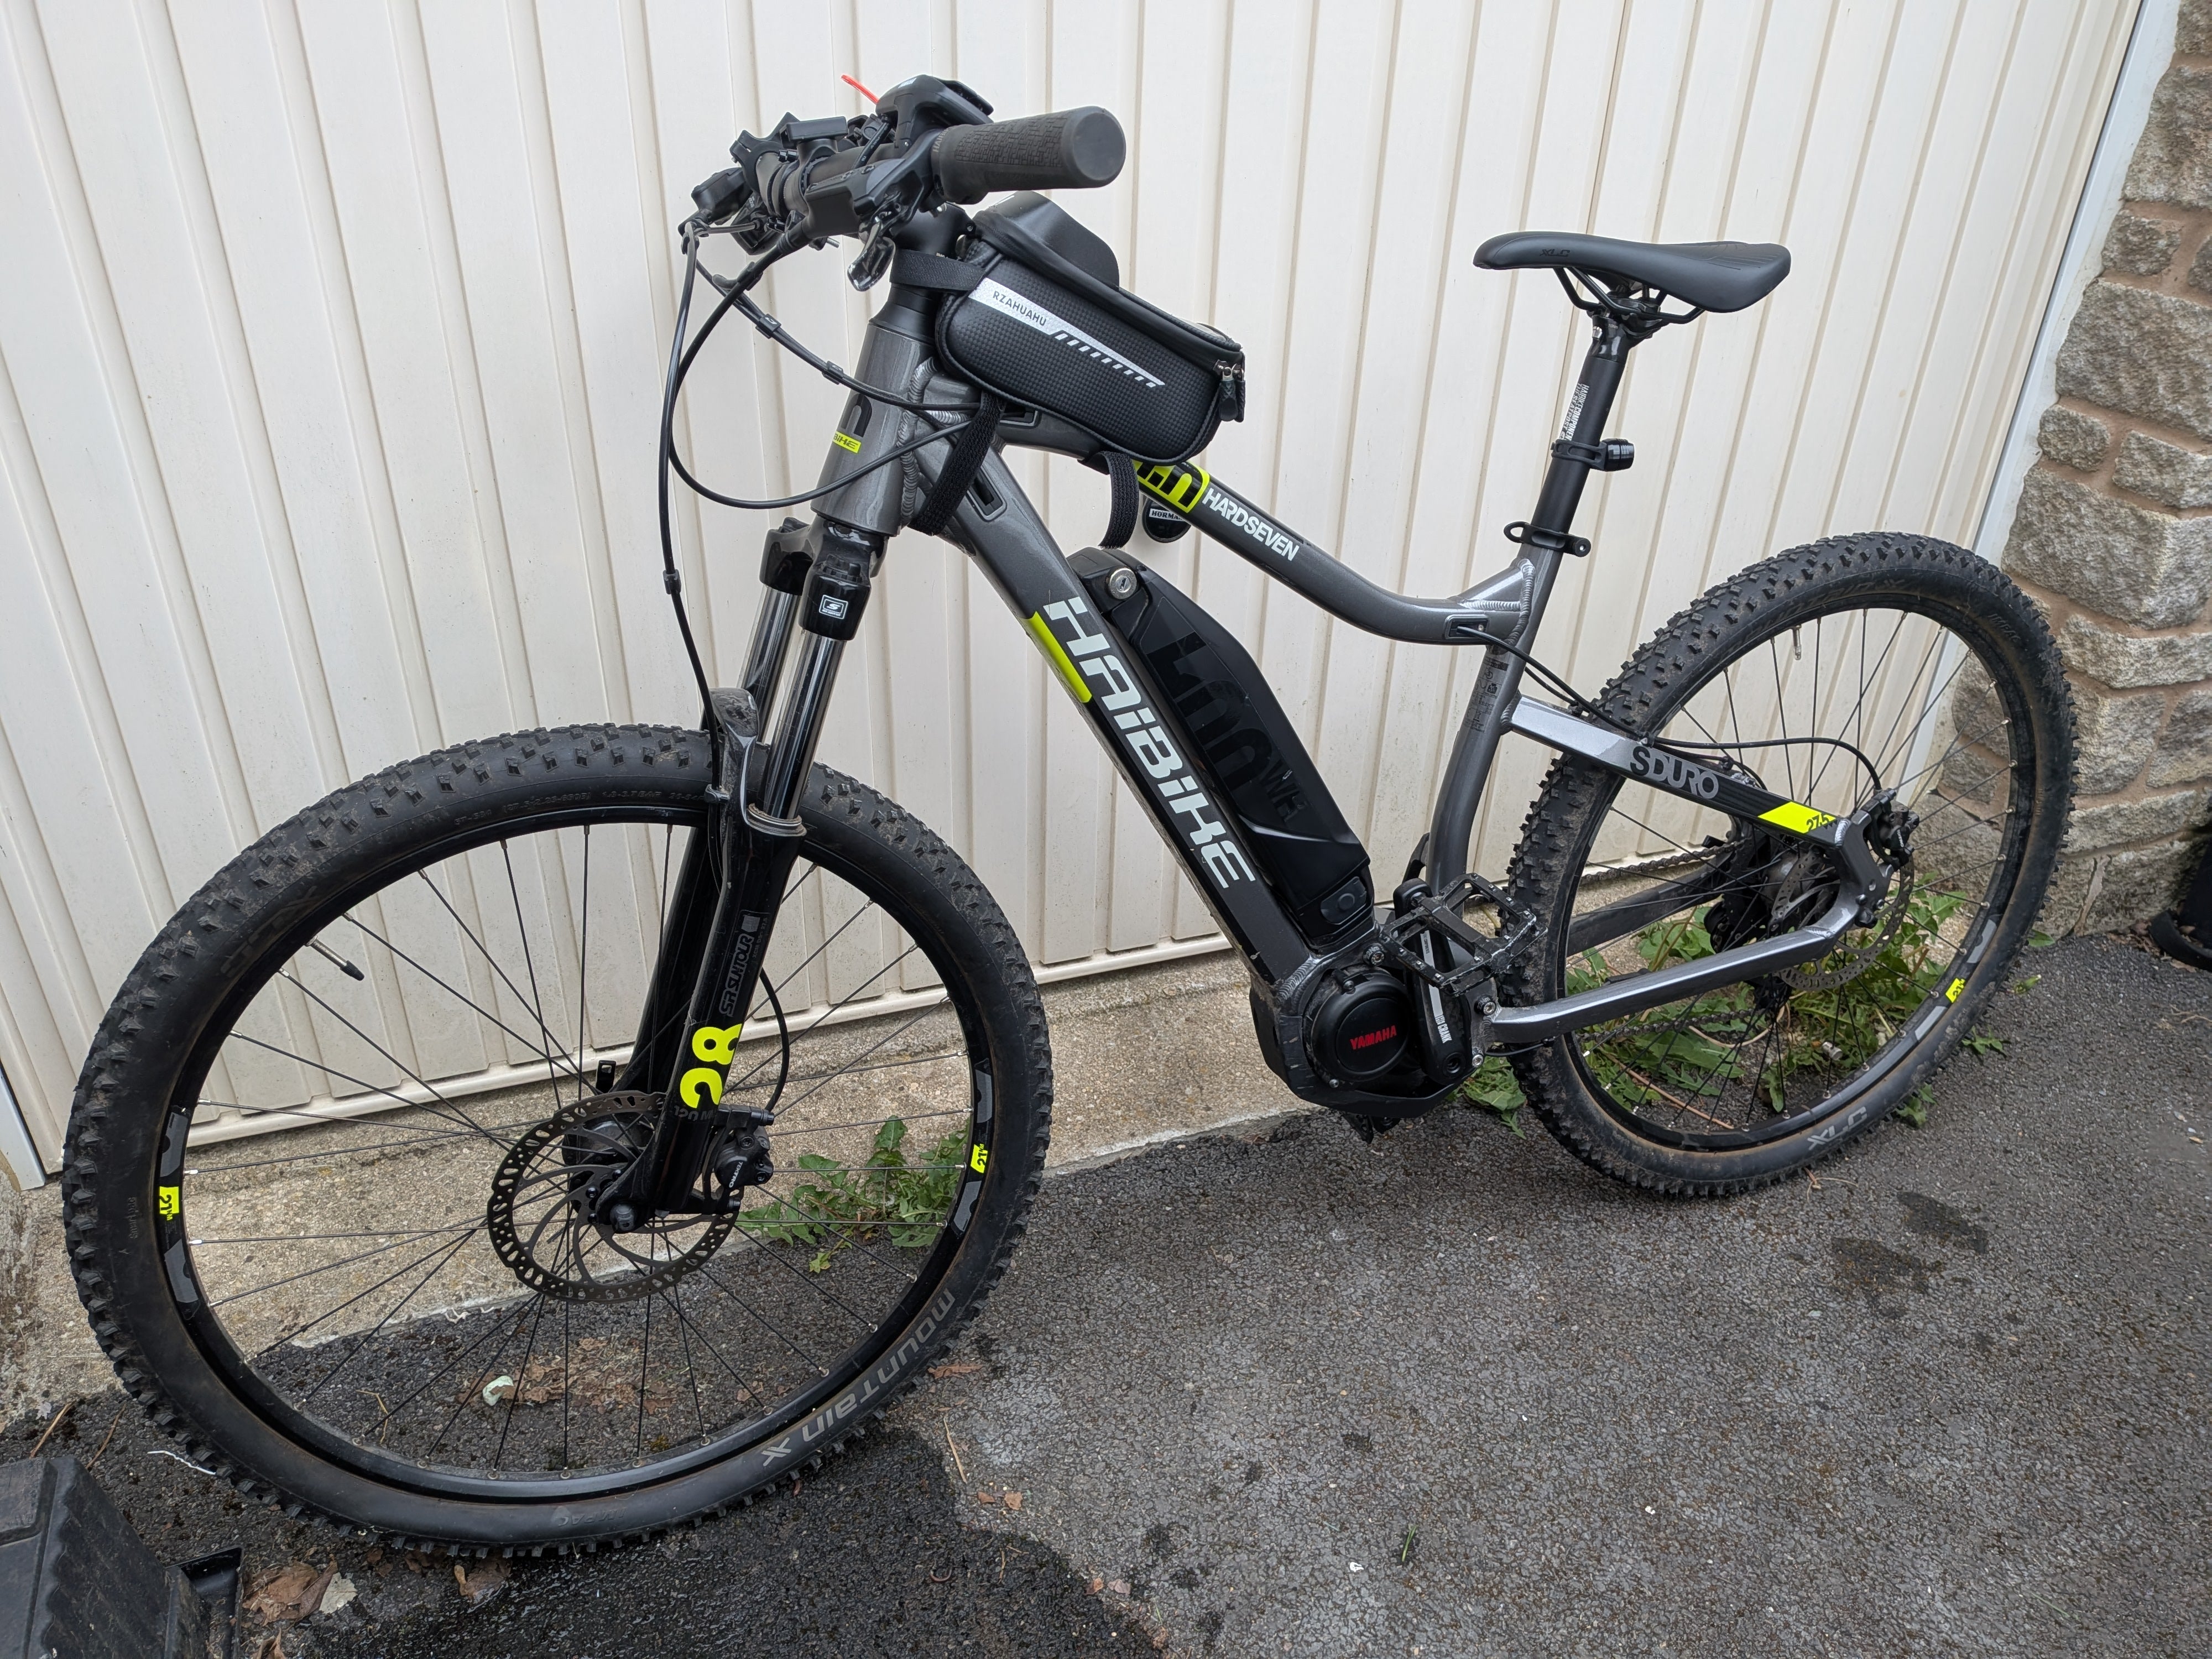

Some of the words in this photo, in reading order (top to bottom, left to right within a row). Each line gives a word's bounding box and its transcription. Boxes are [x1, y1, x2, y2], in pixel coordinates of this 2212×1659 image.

[1540, 248, 1571, 258] XLC
[992, 290, 1047, 327] RZAHUAHU
[1202, 487, 1300, 561] HARDSEVEN
[1630, 745, 1719, 799] SDURO
[1806, 813, 1830, 832] 27.5
[1350, 1025, 1397, 1050] YAMAHA
[1437, 1023, 1453, 1044] CRANK
[1807, 1107, 1867, 1151] XLC
